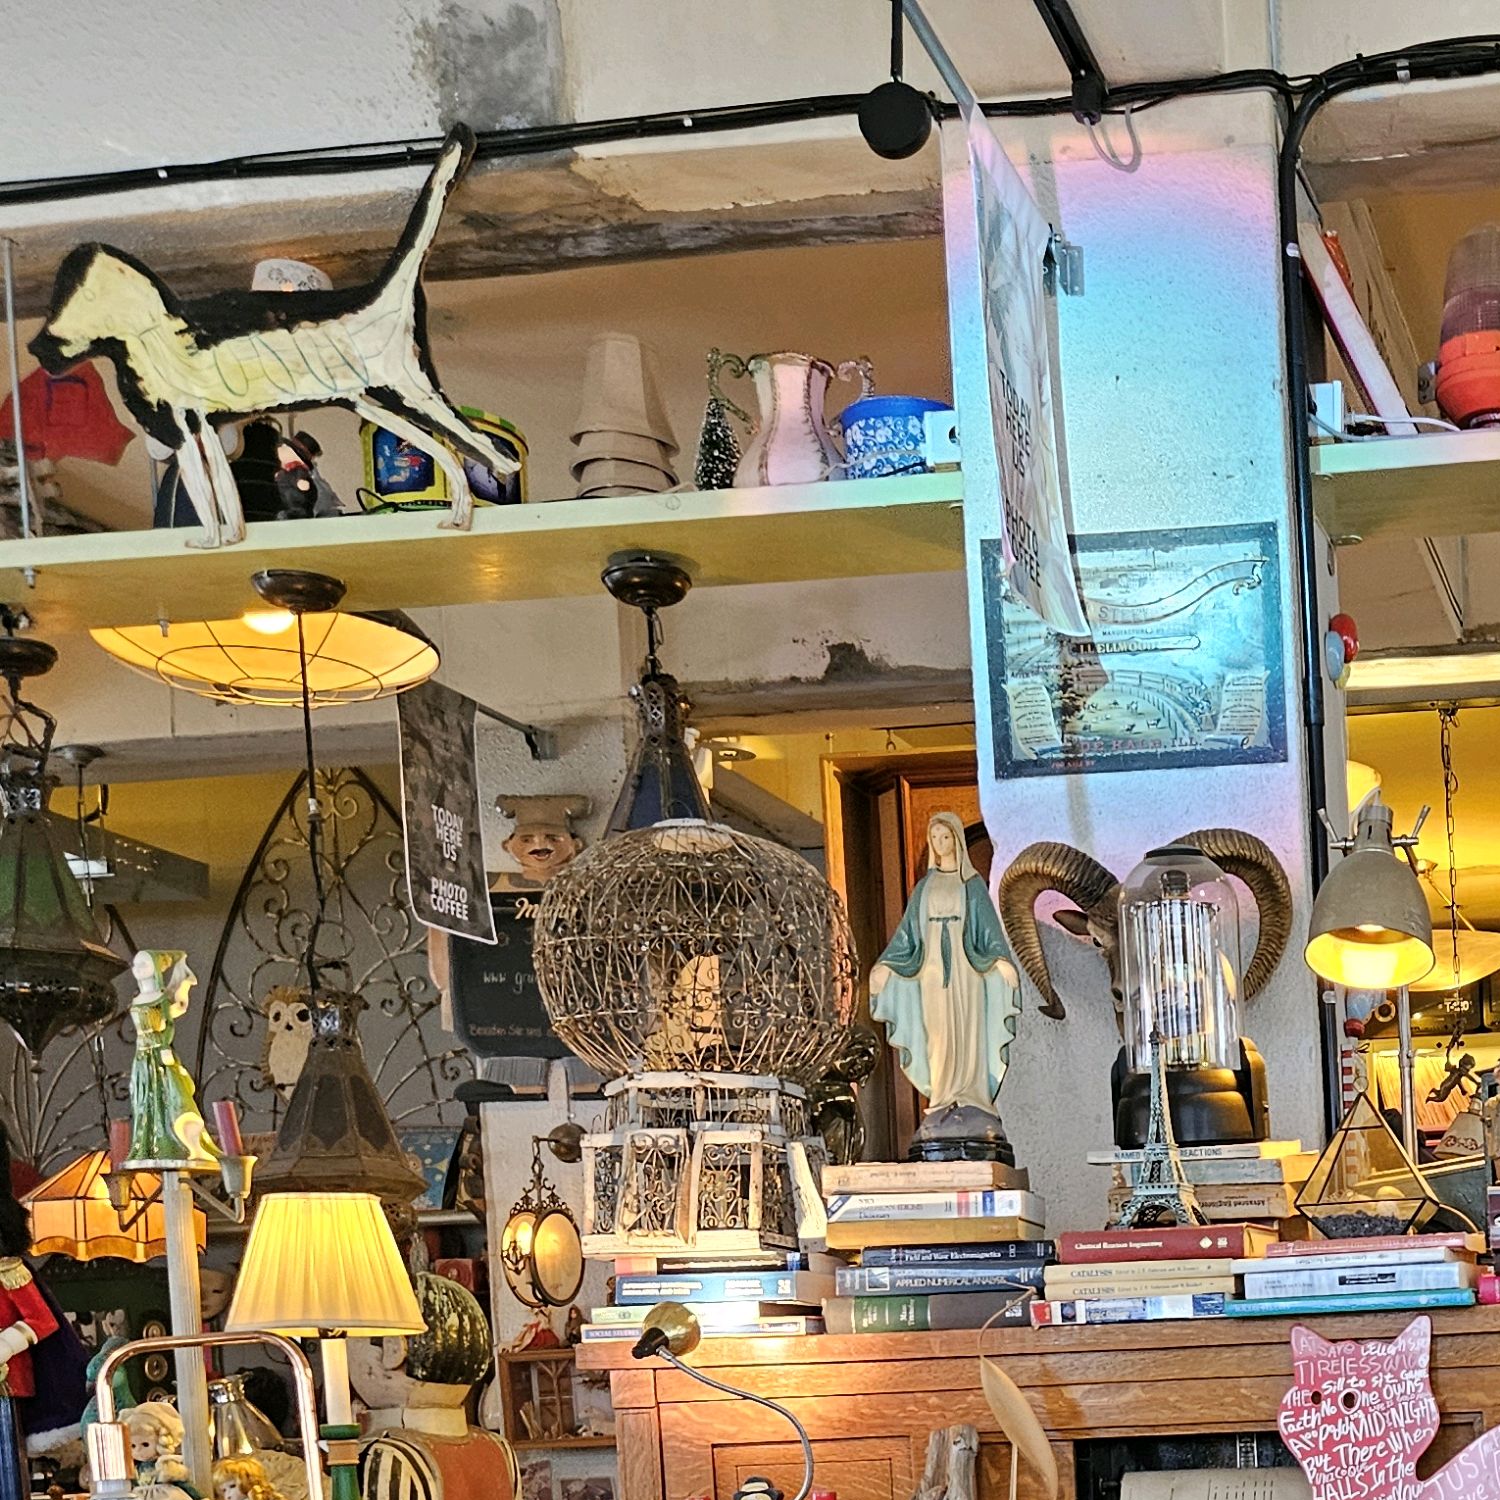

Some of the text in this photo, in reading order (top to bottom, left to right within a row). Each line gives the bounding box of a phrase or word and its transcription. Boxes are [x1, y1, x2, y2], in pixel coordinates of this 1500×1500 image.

[999, 368, 1032, 430] TODAY
[1005, 403, 1031, 457] HERE
[1012, 443, 1025, 479] US
[1005, 498, 1039, 556] PHOTO
[431, 804, 464, 831] TODAY
[435, 826, 463, 848] HERE
[443, 845, 457, 862] US
[430, 876, 468, 903] PHOTO
[430, 896, 469, 921] COFFEE
[895, 1279, 927, 1288] APPLIED
[927, 1278, 971, 1287] NUMERICAL
